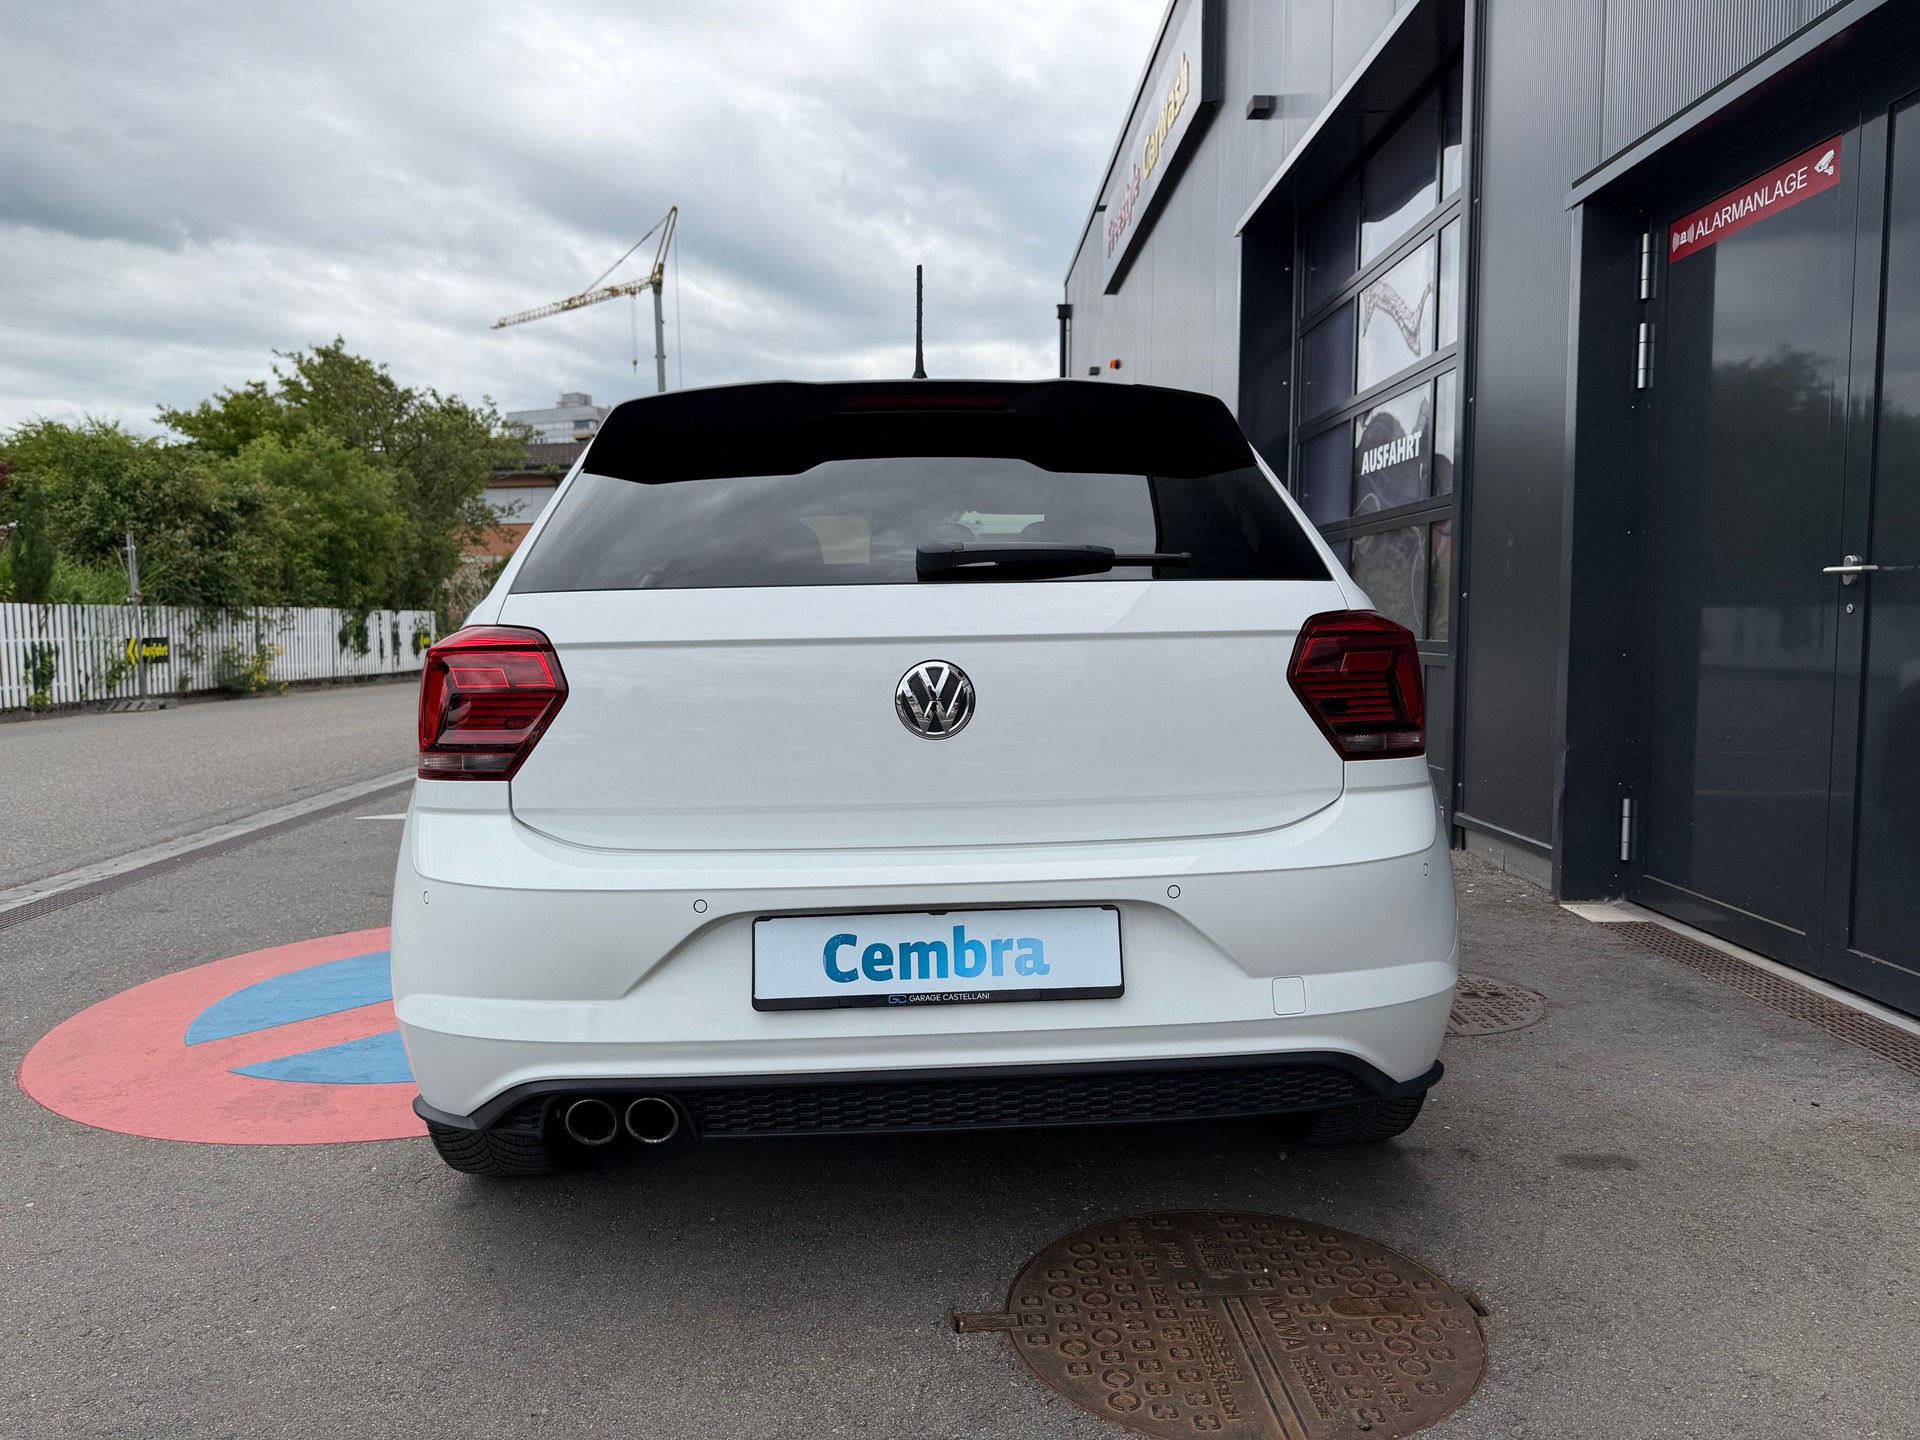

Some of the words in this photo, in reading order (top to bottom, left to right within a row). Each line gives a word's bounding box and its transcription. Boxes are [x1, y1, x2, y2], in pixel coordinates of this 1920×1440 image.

[1694, 165, 1808, 241] ALARMANLAGE
[1360, 430, 1422, 476] AUSFAHRT
[822, 924, 1051, 984] Cembra
[908, 993, 941, 1002] GARAGE
[942, 991, 990, 1001] CASTELLANI
